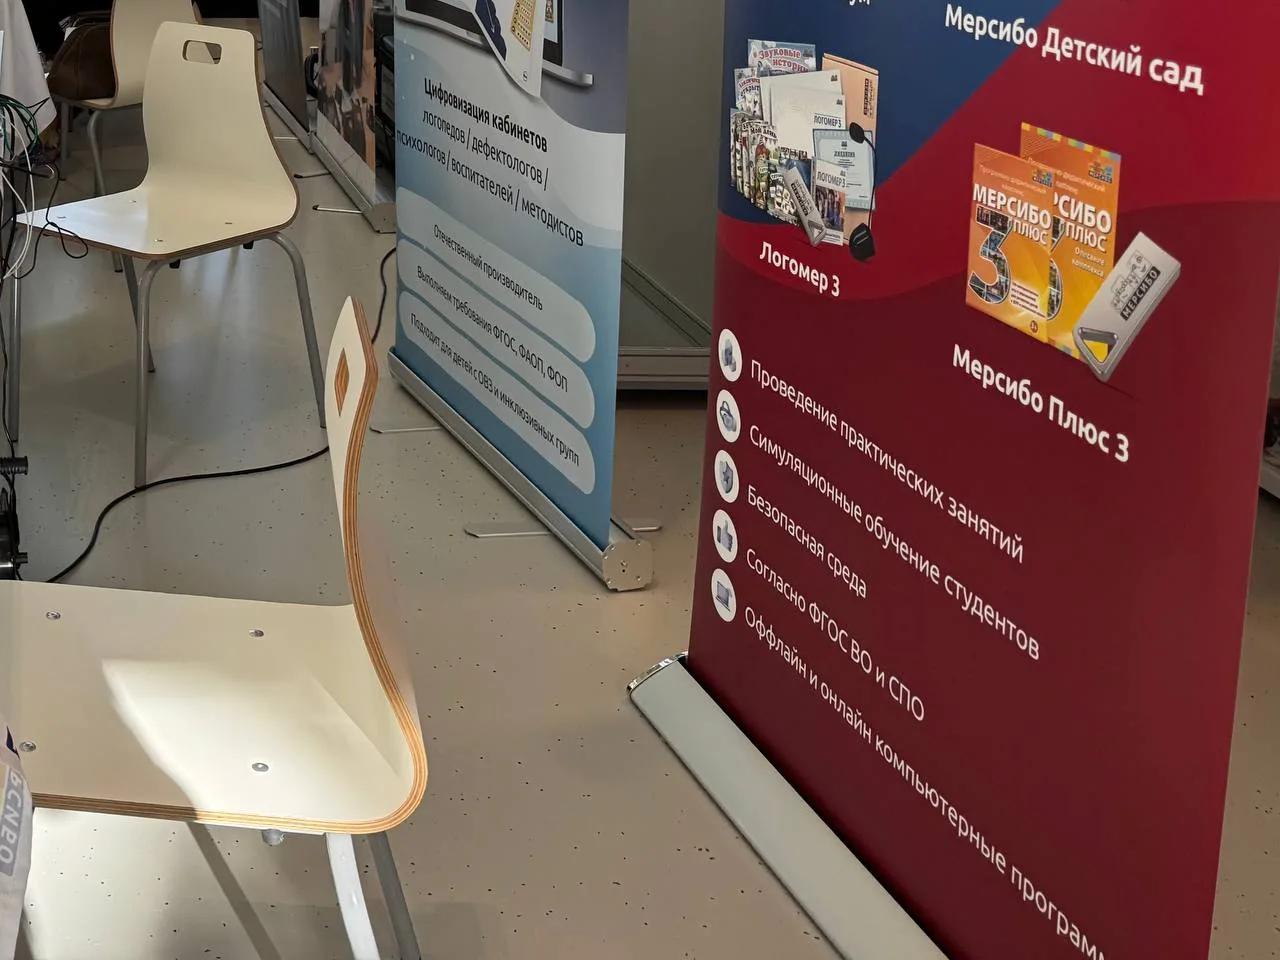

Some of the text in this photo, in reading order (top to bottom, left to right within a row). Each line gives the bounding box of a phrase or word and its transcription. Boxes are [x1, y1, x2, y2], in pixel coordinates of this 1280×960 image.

[945, 3, 1204, 96] Мерсибо Детский сад
[422, 110, 465, 144] логопедов
[471, 136, 543, 185] дефектологов
[424, 77, 548, 153] Цифровизация кабинетов
[814, 114, 837, 128] ЛОГОМЕР
[396, 129, 446, 166] психологов
[451, 157, 514, 203] воспитателей
[521, 201, 584, 247] методистов
[817, 170, 841, 185] ЛОГОМЕР
[973, 183, 1052, 230] МЕРСИБО
[433, 224, 543, 311] Отечественный производитель
[759, 240, 840, 297] Логомер 3
[969, 203, 1013, 305] 3
[1012, 218, 1048, 246] ПЛЮС
[1064, 221, 1108, 253] ПЛЮС
[416, 265, 568, 393] Выполняем требования ФГОС, ФАОП, ФОП
[1122, 268, 1160, 320] МЕРСИБО
[440, 341, 453, 359] для
[452, 351, 474, 376] детей
[477, 370, 493, 392] ОВЗ
[499, 389, 555, 444] инклюзивных
[555, 435, 580, 467] групп
[953, 342, 1130, 462] Мерсибо Плюс 3
[750, 359, 1024, 564] Проведение практических занятий
[747, 484, 867, 599] Безопасная среда
[749, 424, 1040, 661] Симуляционные обучение студентов
[746, 548, 925, 722] Согласно ФГОС ВО и СПО
[744, 606, 807, 679] Оффлайн
[809, 670, 818, 691] и
[820, 680, 872, 744] онлайн
[875, 734, 1007, 875] компьютерные
